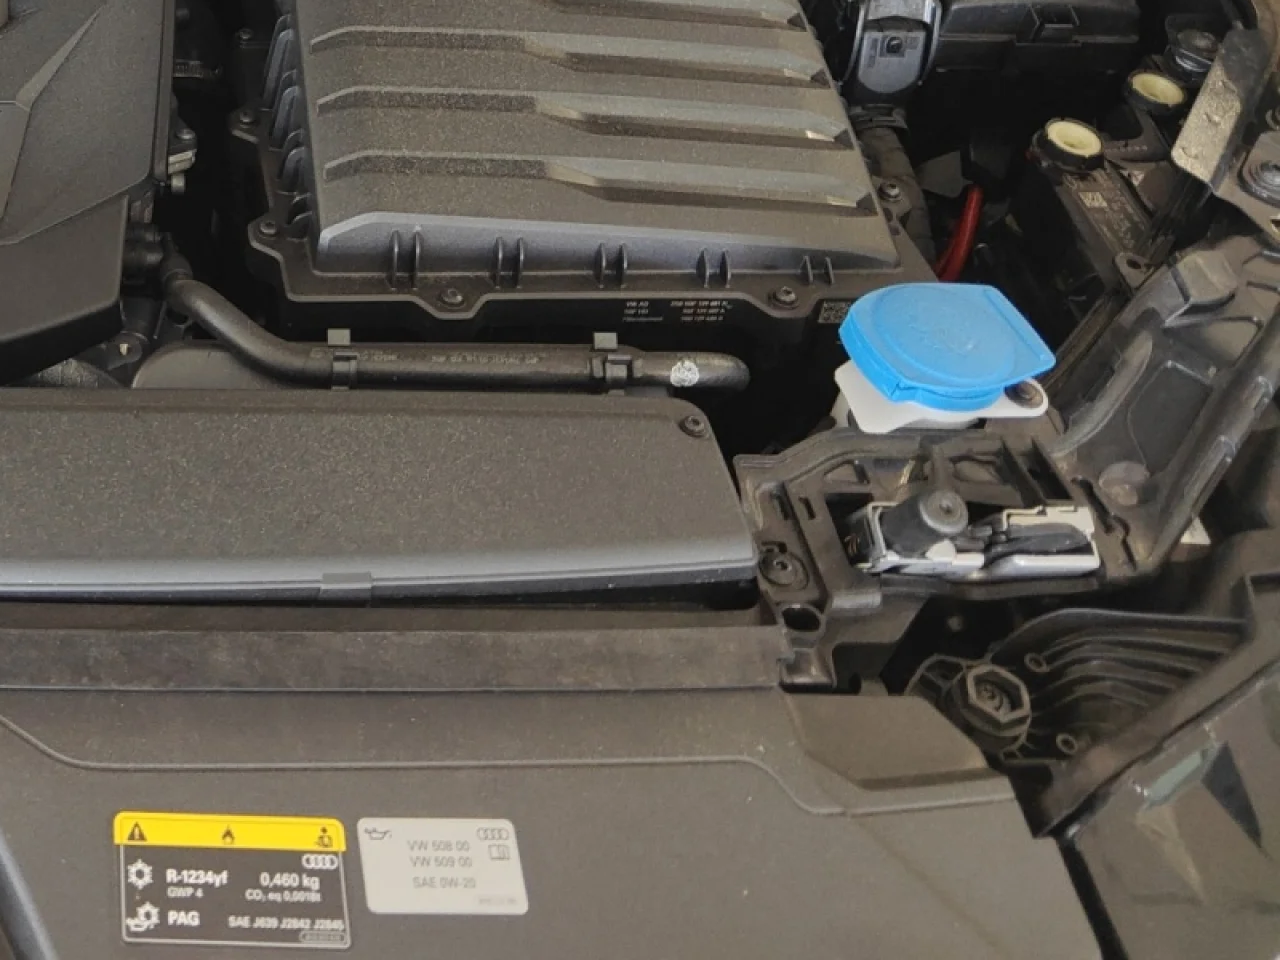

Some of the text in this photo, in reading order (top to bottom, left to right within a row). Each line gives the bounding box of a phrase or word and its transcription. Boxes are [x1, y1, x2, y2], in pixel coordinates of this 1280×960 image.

[407, 840, 470, 852] VW 508 00
[409, 856, 473, 868] VW 509 00
[166, 868, 228, 888] R-1234yf
[302, 873, 320, 891] kg
[412, 876, 437, 889] SAE
[167, 910, 200, 926] PAG
[227, 915, 250, 928] SAE
